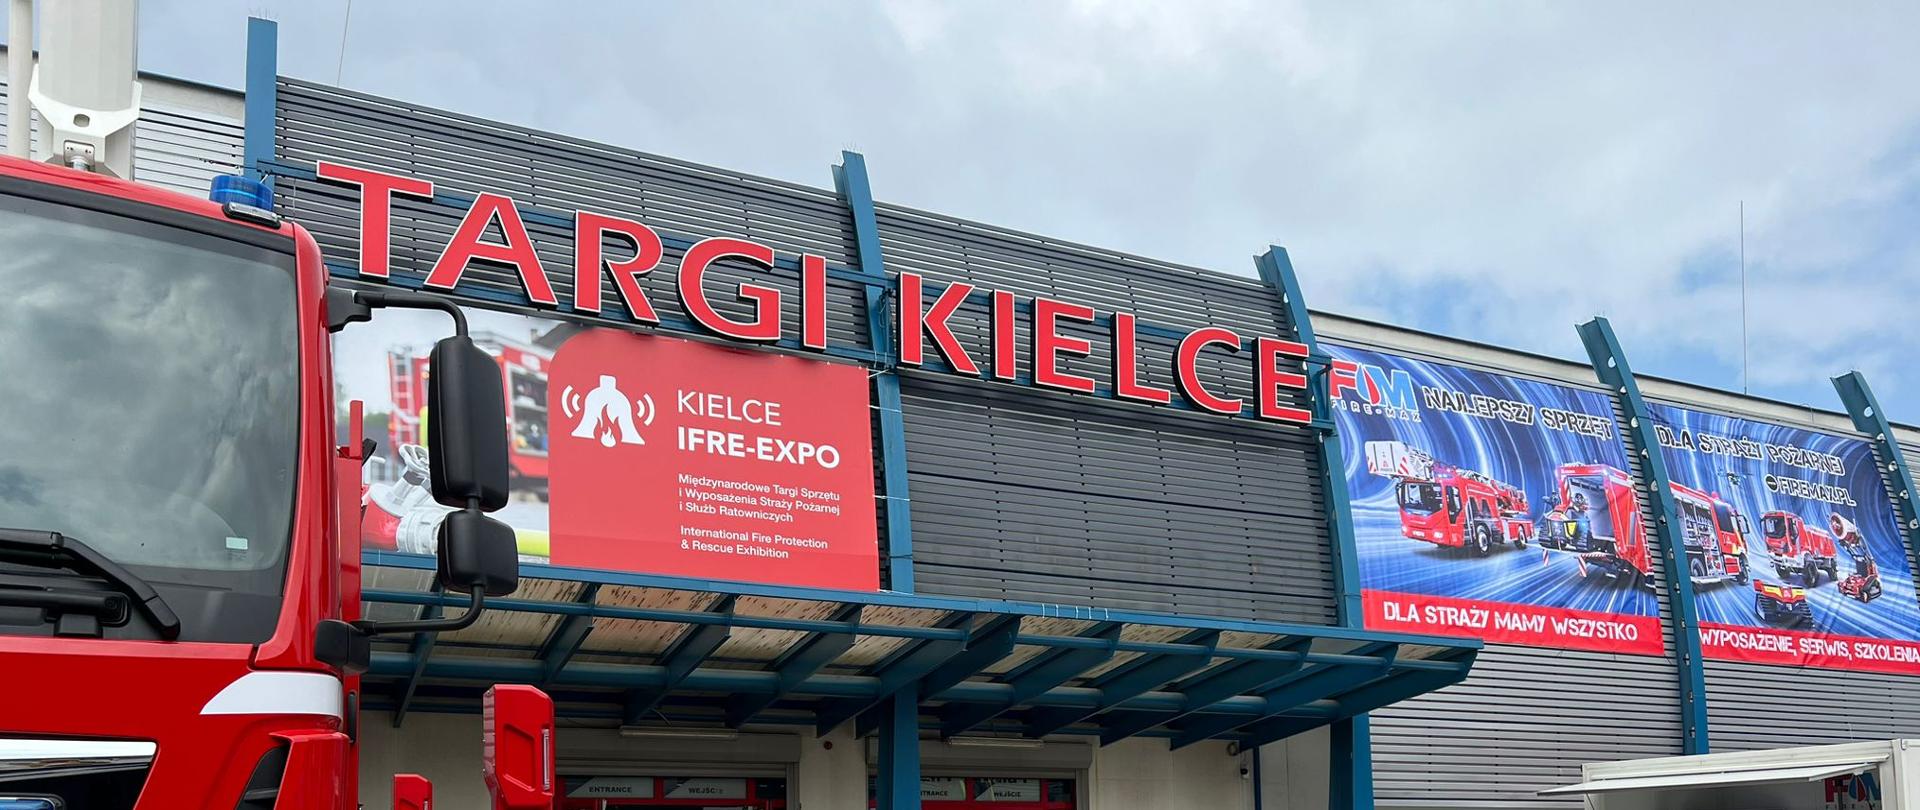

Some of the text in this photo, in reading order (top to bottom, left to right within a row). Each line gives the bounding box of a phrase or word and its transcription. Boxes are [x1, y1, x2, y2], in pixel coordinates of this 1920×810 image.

[316, 160, 1313, 425] TARGI KIELCE
[677, 389, 782, 426] KIELCE
[1421, 386, 1534, 425] NAJLEPSZY
[677, 426, 840, 469] IFRE-EXPO
[1653, 425, 1845, 476] DLA STRAŻY POŻARNEJ
[678, 473, 840, 501] Międzynarodowe Targi Sprzętu
[678, 488, 840, 516] i Wyposażenia Straży Pożarnej
[1778, 476, 1857, 506] FIREMAX.PL
[679, 502, 794, 523] i Służb Ratowniczych
[680, 525, 828, 549] International Fire Protection
[680, 539, 789, 559] & Rescue Exhibition
[1383, 601, 1638, 640] DLA STRAŻY MAMY WSZYSTKO
[1699, 628, 1797, 656] WYPOSAŻENIE,
[1799, 638, 1853, 660] SERWIS,
[589, 786, 633, 794] ENTRANCE
